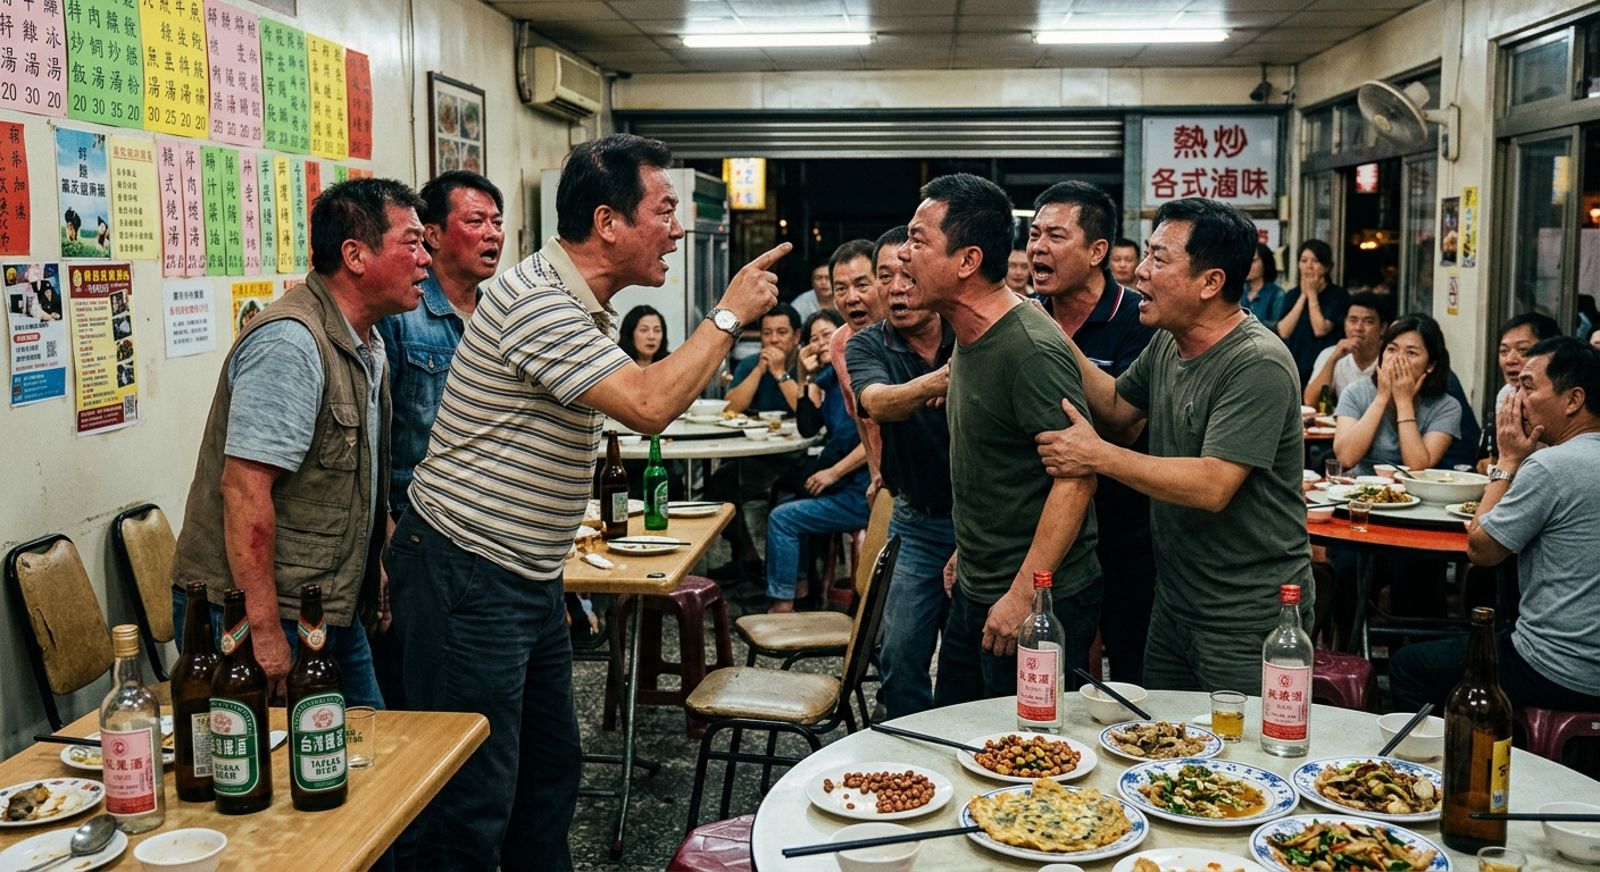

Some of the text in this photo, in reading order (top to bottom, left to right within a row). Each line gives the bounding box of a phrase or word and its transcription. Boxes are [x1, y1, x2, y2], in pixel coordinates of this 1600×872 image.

[1, 82, 17, 101] 20
[25, 86, 40, 106] 30
[47, 91, 61, 109] 20
[73, 94, 87, 112] 20
[92, 98, 105, 115] 30
[111, 101, 123, 118] 35
[127, 104, 140, 121] 20
[148, 106, 160, 122] 30
[165, 109, 177, 125] 25
[195, 115, 206, 130] 20
[1173, 125, 1249, 159] 熱炒
[1151, 167, 1269, 199] 各式滷味
